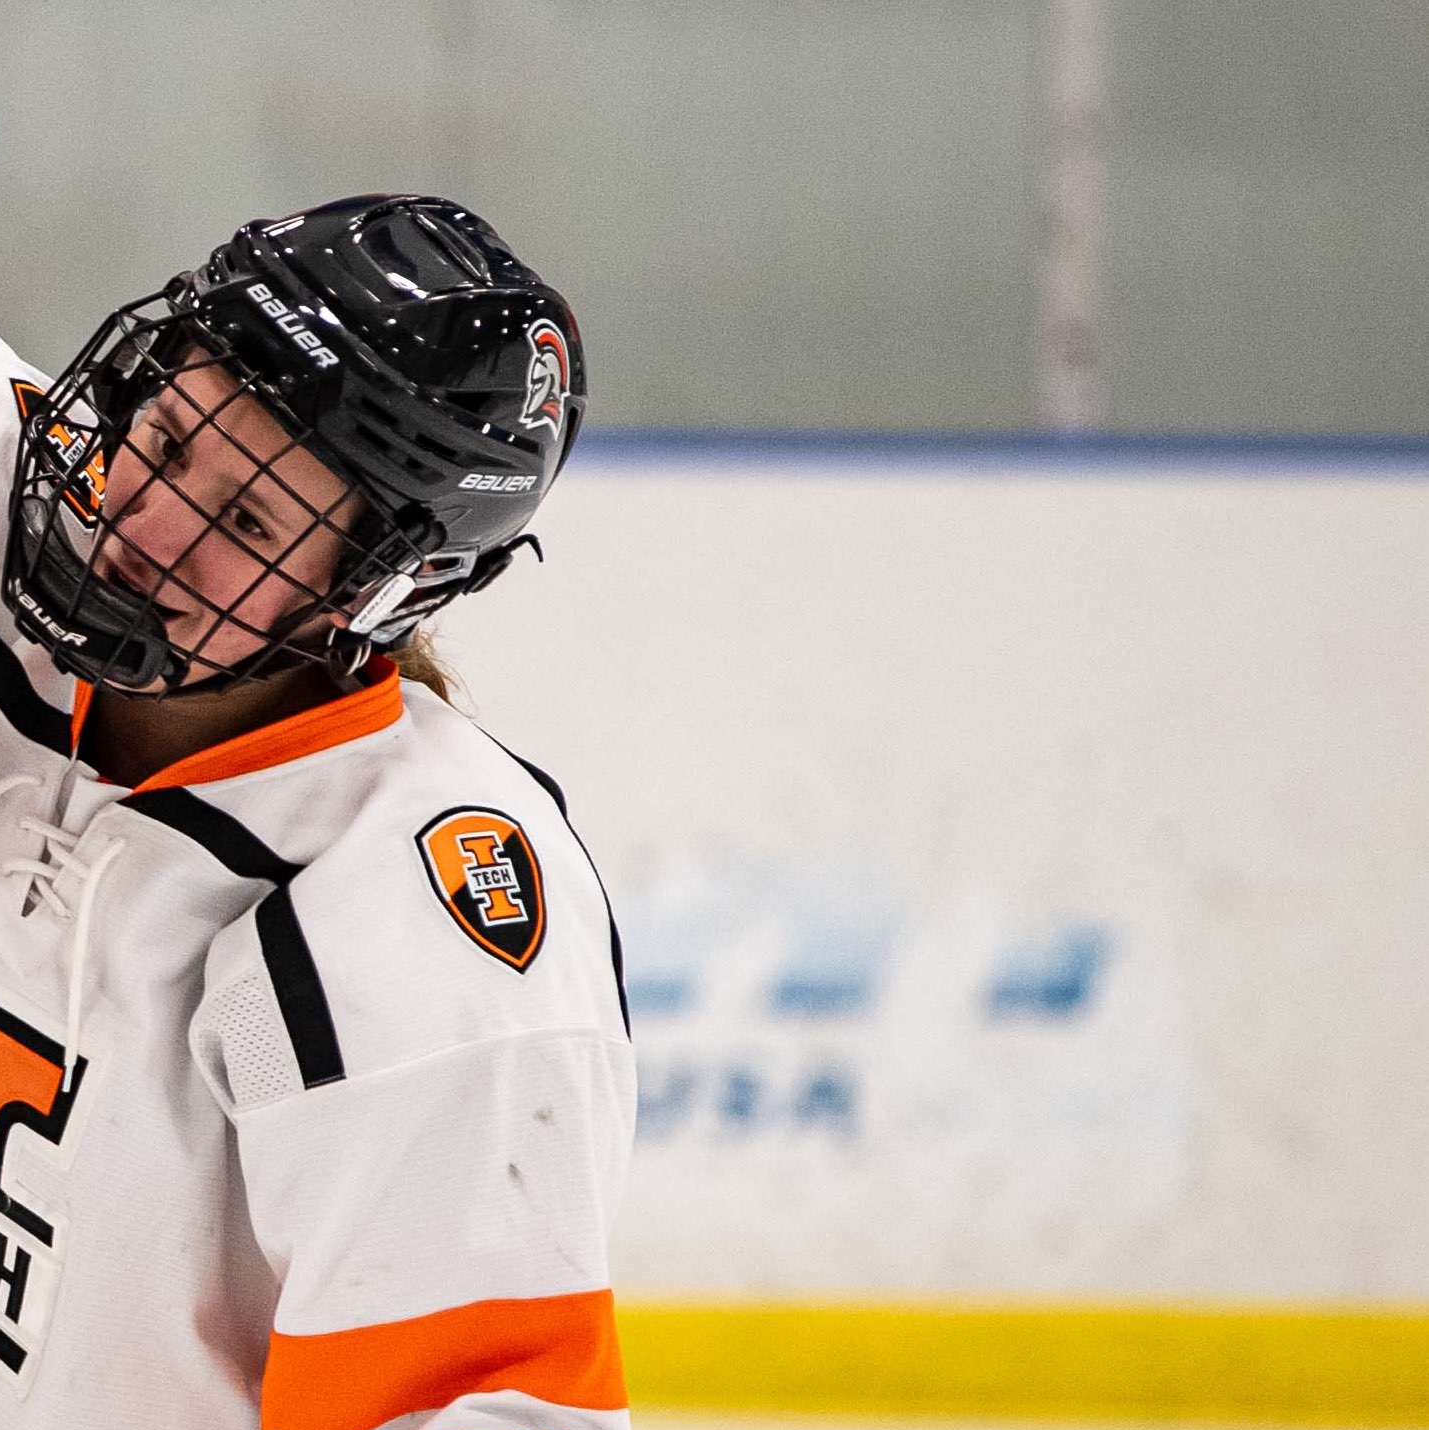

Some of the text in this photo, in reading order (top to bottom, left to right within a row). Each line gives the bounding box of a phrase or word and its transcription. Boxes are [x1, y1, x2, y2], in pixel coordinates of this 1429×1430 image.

[246, 283, 340, 368] BAUER
[457, 473, 538, 491] BAUER
[472, 869, 512, 887] TECH
